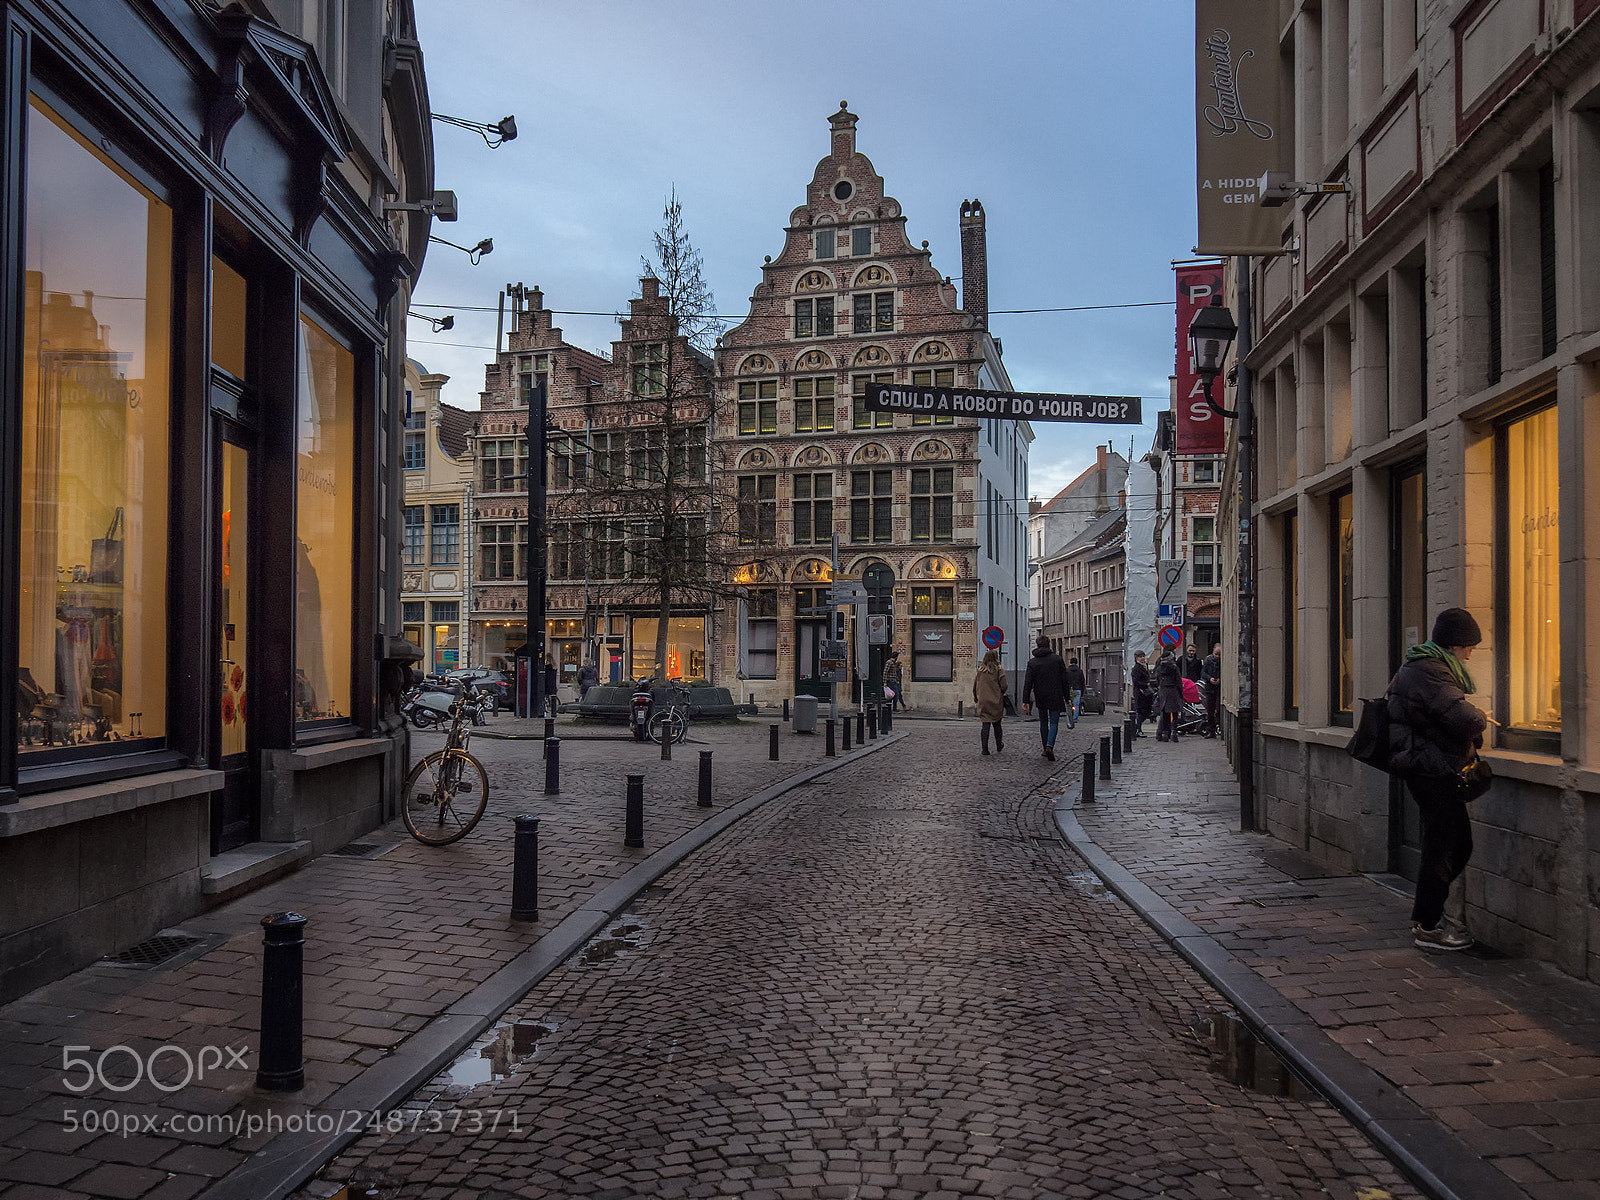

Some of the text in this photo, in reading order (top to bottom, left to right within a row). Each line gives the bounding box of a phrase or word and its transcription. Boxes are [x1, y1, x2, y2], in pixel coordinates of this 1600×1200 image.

[1202, 179, 1213, 189] A
[1223, 193, 1255, 204] GEM
[37, 339, 140, 408] Garderobe
[878, 389, 1129, 419] COULD A ROBOT DO YOUR JOB?
